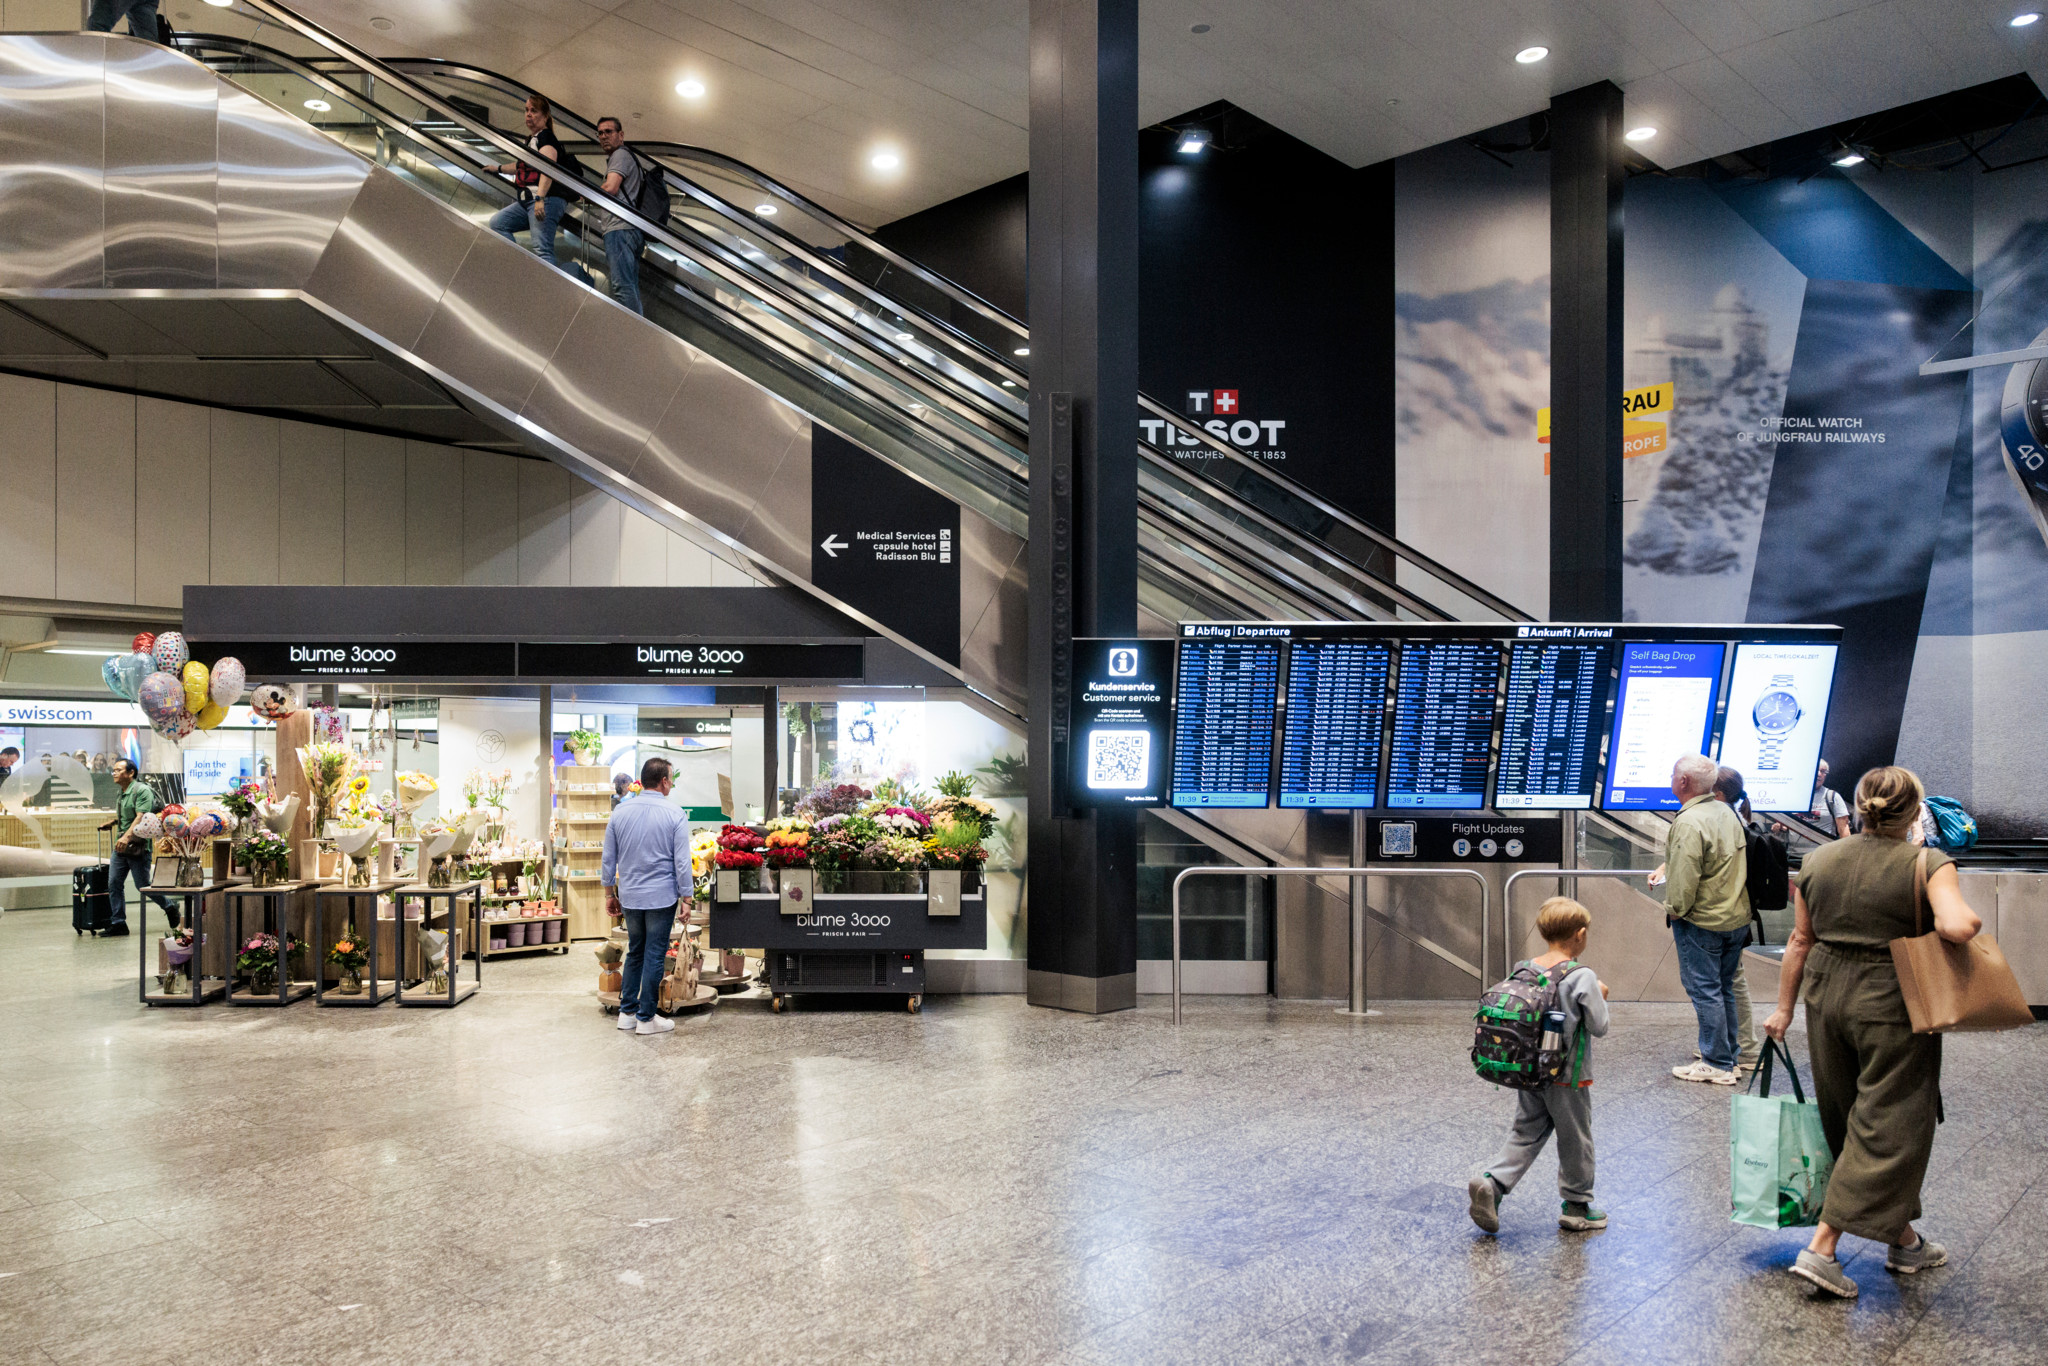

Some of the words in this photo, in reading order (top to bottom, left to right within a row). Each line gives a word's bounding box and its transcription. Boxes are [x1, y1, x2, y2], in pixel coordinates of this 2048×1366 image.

[1760, 418, 1815, 428] OFFICIAL
[1818, 418, 1862, 428] WATCH
[1737, 432, 1754, 441] OF
[1757, 432, 1822, 442] JUNGFRAU
[1825, 433, 1885, 443] RAILWAYS
[1175, 451, 1225, 460] WATCHES
[1263, 451, 1286, 460] 1853
[2017, 445, 2044, 471] 40
[896, 532, 936, 540] Services
[873, 542, 909, 551] capsule
[1196, 626, 1230, 638] Abflug
[1237, 627, 1290, 638] Departure
[1530, 628, 1571, 637] Ankunft
[1577, 628, 1613, 638] Arrival
[290, 645, 346, 662] blume
[637, 646, 692, 662] blume
[1631, 651, 1650, 660] Self
[1652, 651, 1670, 662] Bag
[1672, 651, 1696, 662] Drop
[1089, 682, 1155, 691] Kundenservice
[1083, 693, 1126, 702] Customer
[1128, 694, 1160, 702] service
[8, 705, 92, 720] swisscom
[705, 723, 731, 732] Sunrise
[189, 769, 202, 779] flip
[1452, 824, 1480, 835] Flight
[1482, 824, 1525, 834] Updates
[796, 914, 845, 927] blume
